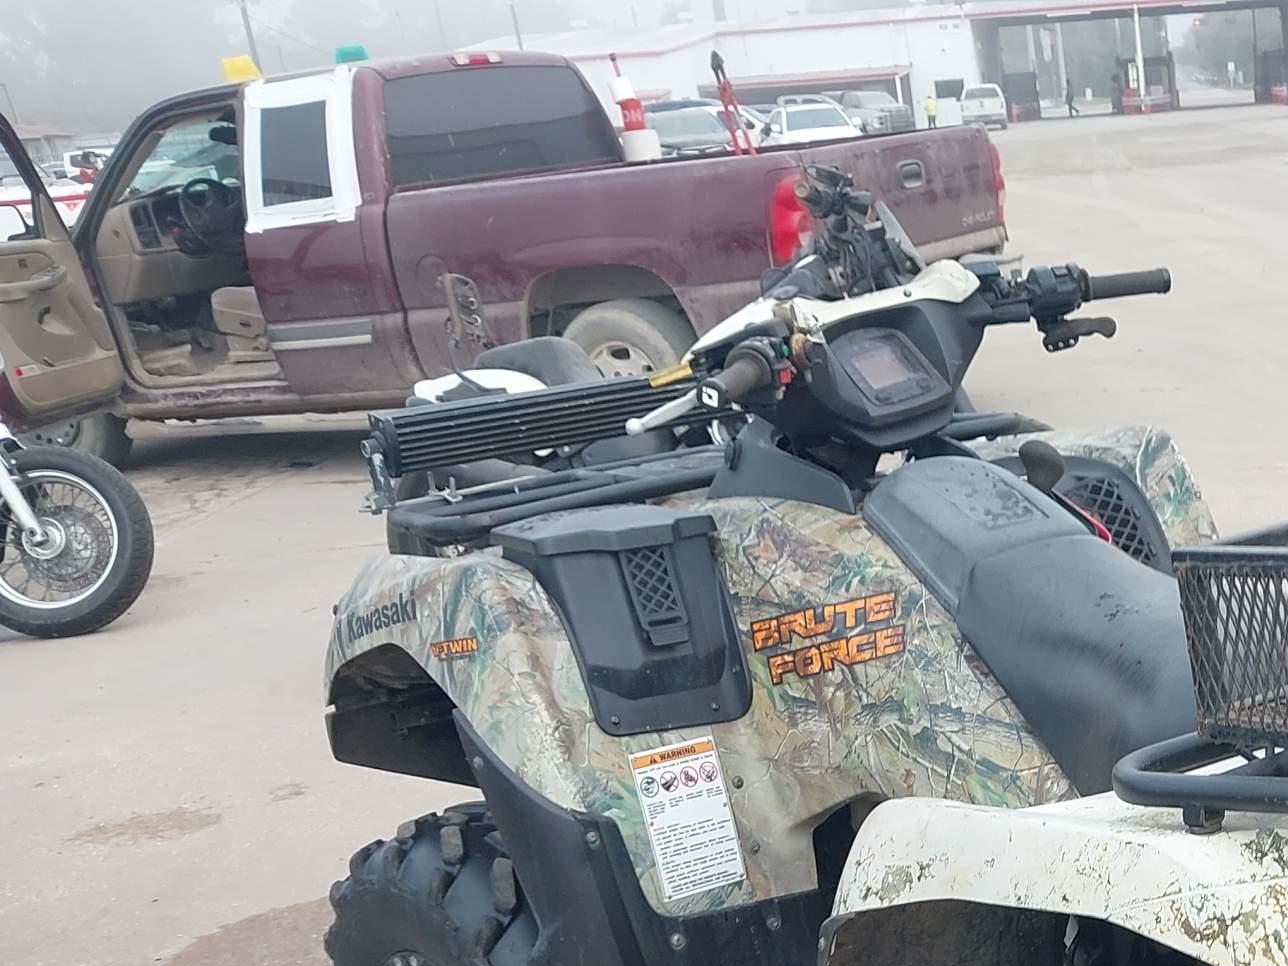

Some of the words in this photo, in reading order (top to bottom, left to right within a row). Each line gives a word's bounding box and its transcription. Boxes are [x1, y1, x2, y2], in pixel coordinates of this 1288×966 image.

[346, 589, 418, 643] Kawasaki
[750, 591, 897, 652] BRUTE
[767, 623, 906, 686] FORCE
[658, 745, 697, 761] WARNING
